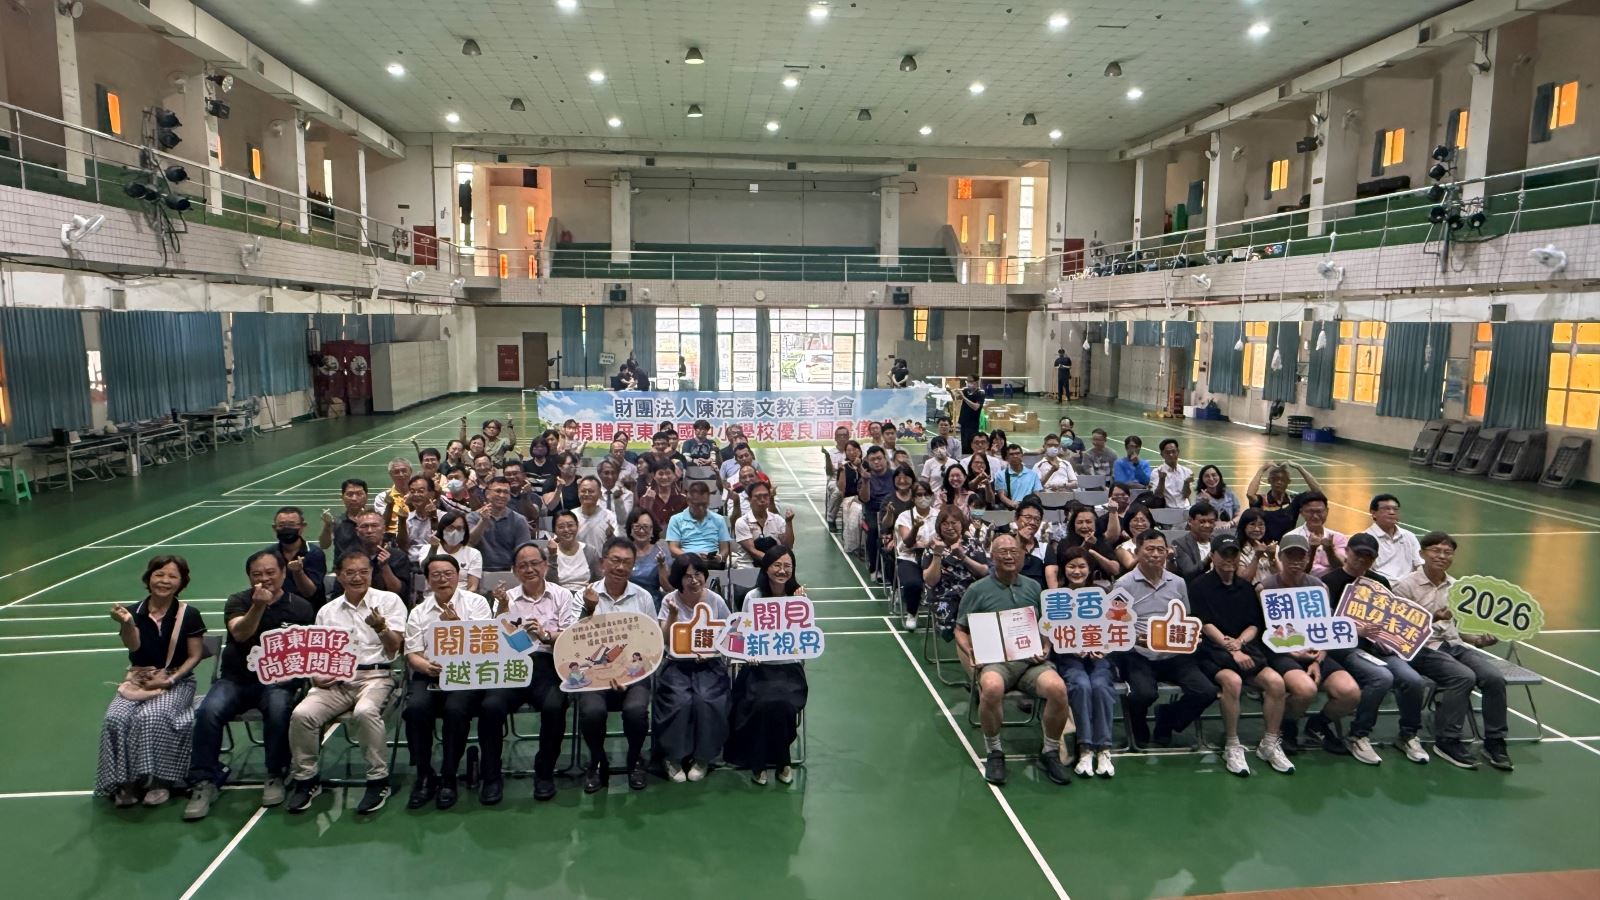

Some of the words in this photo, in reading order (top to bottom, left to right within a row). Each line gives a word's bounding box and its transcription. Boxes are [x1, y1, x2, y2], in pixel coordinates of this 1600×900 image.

[615, 396, 854, 418] 財團法人陳沼濤文教基金會
[753, 601, 811, 631] 閱見
[1046, 591, 1103, 621] 書香
[1265, 590, 1324, 620] 翻閱
[1457, 585, 1532, 632] 2026
[264, 630, 348, 654] 屏東囡仔
[434, 624, 499, 656] 閱讀
[747, 630, 821, 657] 新視界
[1054, 623, 1131, 648] 悅童年
[1306, 620, 1354, 644] 世界
[260, 651, 354, 679] 尚愛閱讀
[445, 659, 529, 685] 越有趣
